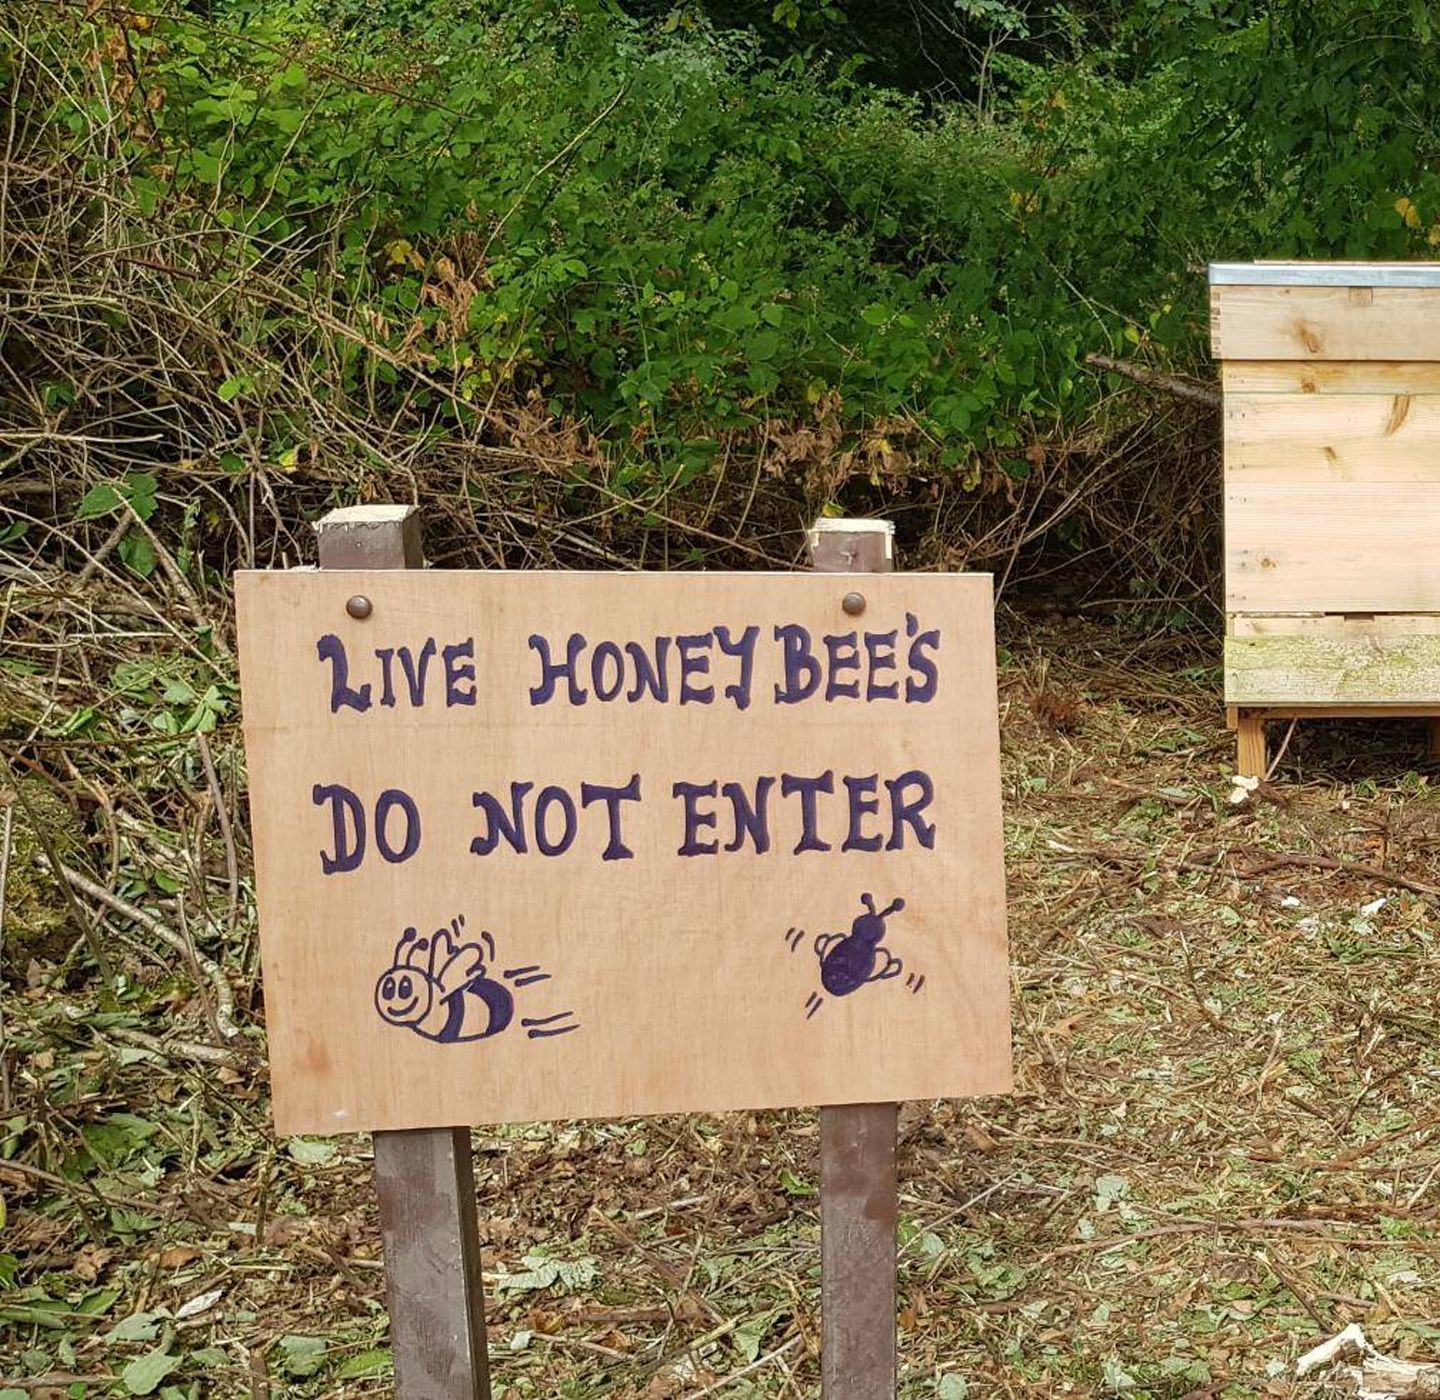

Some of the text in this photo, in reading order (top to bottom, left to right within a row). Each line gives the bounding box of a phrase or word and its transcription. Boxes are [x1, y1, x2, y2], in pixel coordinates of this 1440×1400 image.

[316, 633, 478, 714] LIVE
[312, 769, 937, 876] DO NOT ENTER
